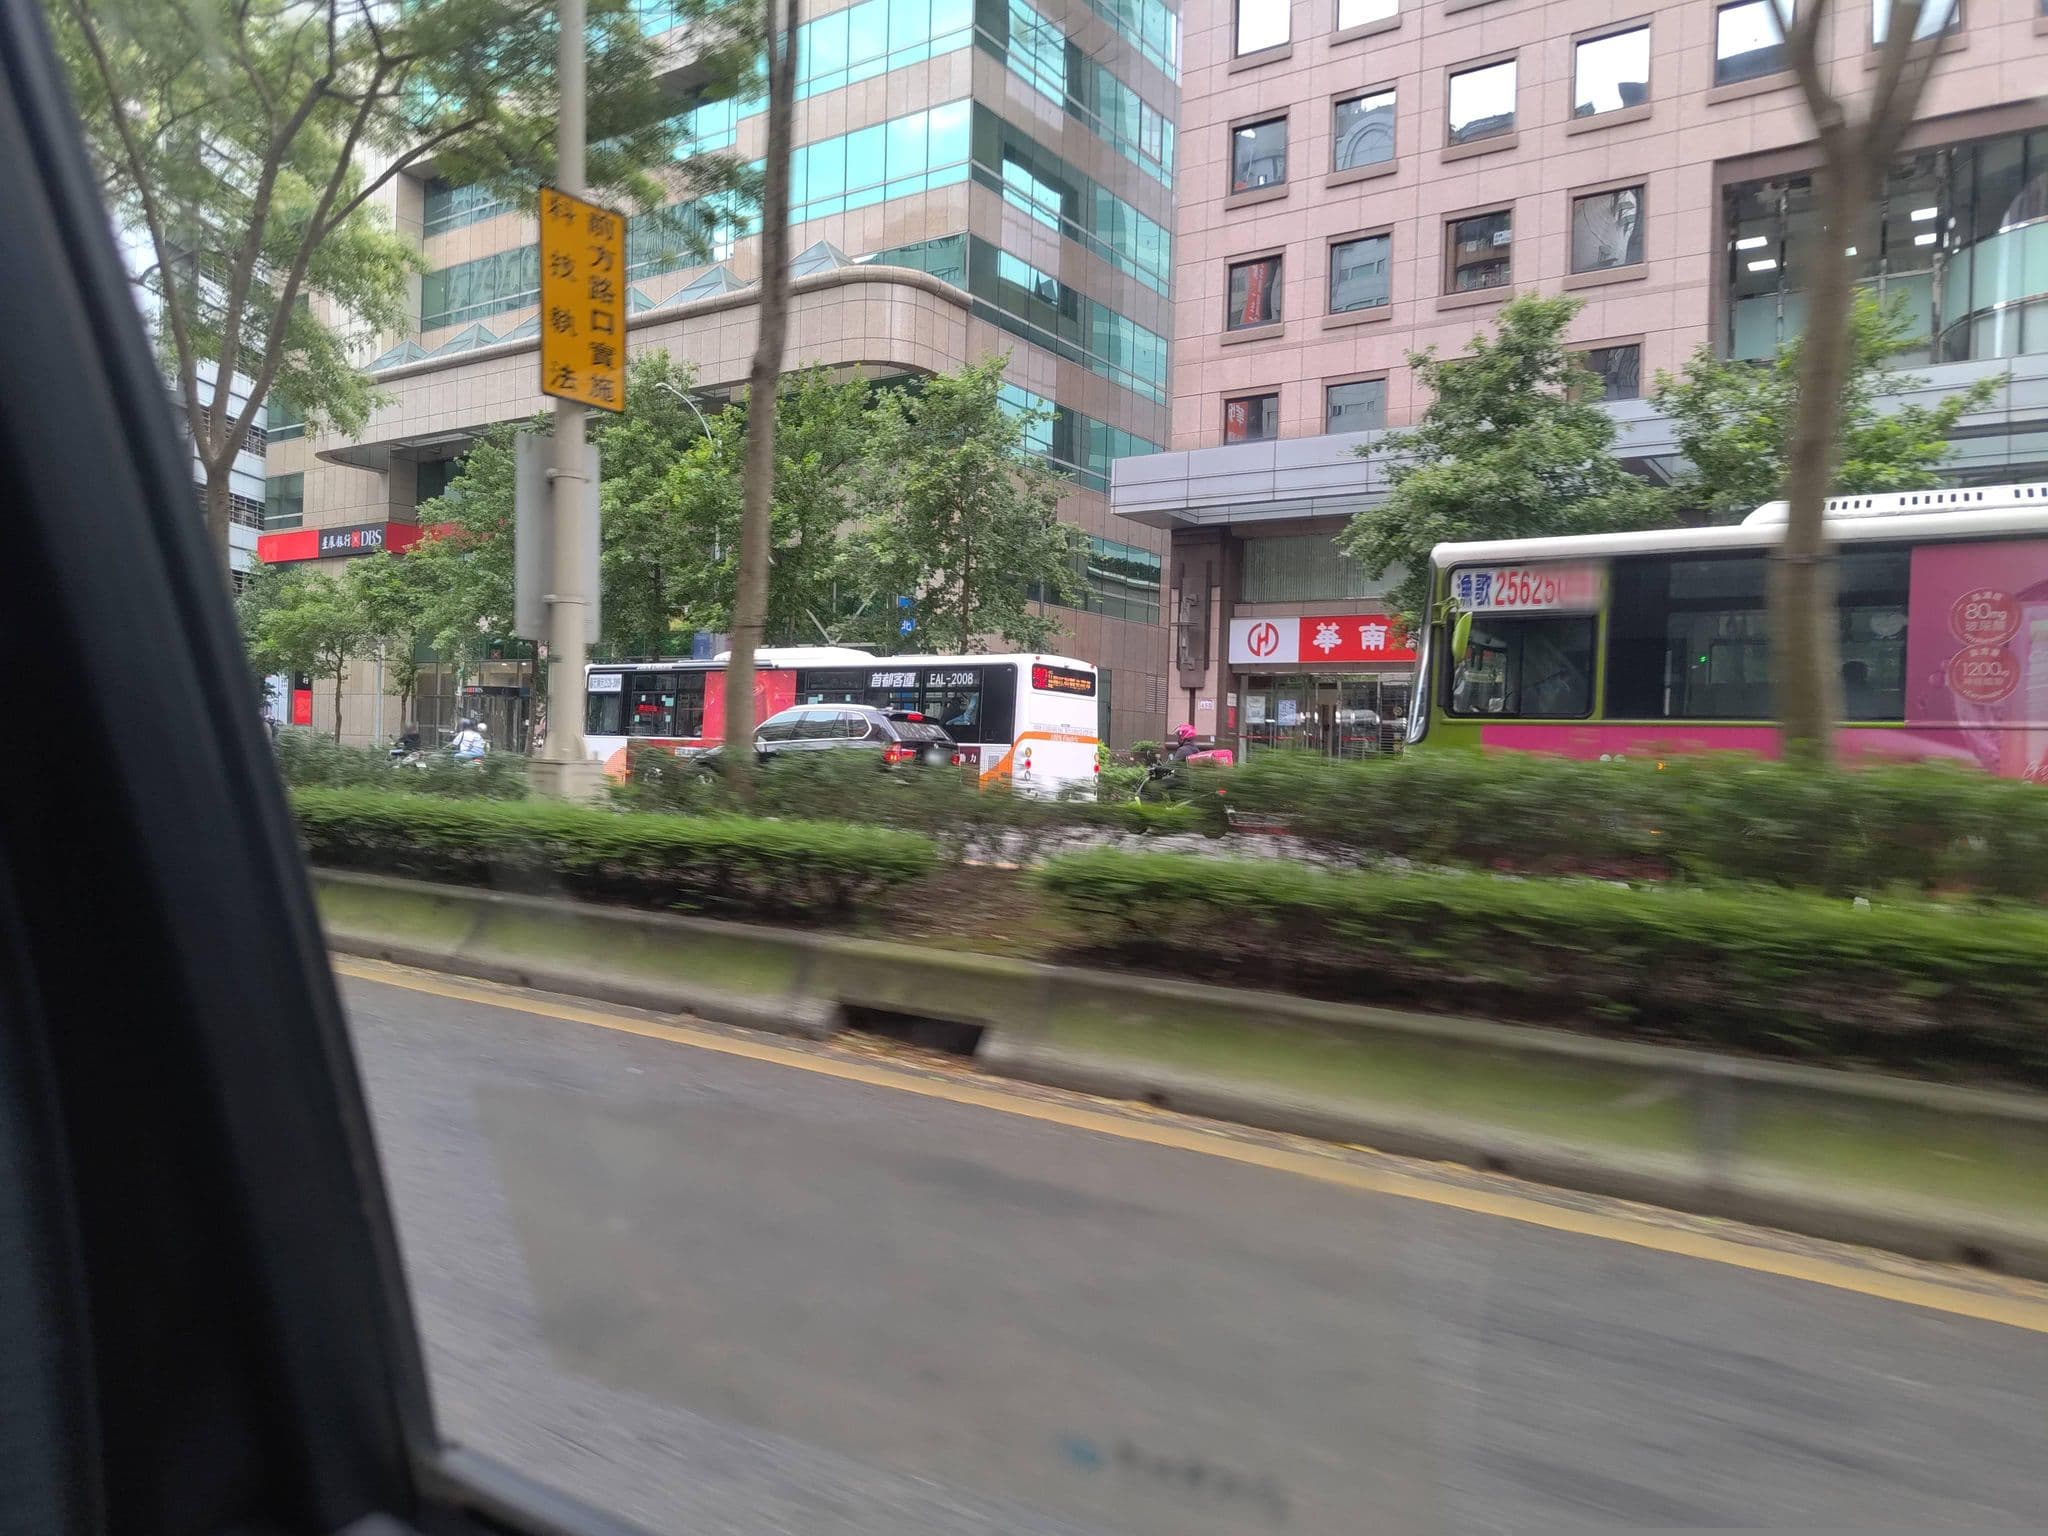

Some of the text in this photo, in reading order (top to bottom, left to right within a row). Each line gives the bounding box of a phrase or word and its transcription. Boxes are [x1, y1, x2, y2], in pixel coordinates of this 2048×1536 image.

[548, 195, 577, 391] 科技執法
[587, 212, 616, 403] 前方路口實施
[360, 529, 382, 547] DBS
[870, 672, 917, 688] 首都客運
[930, 673, 974, 686] EAL-2008
